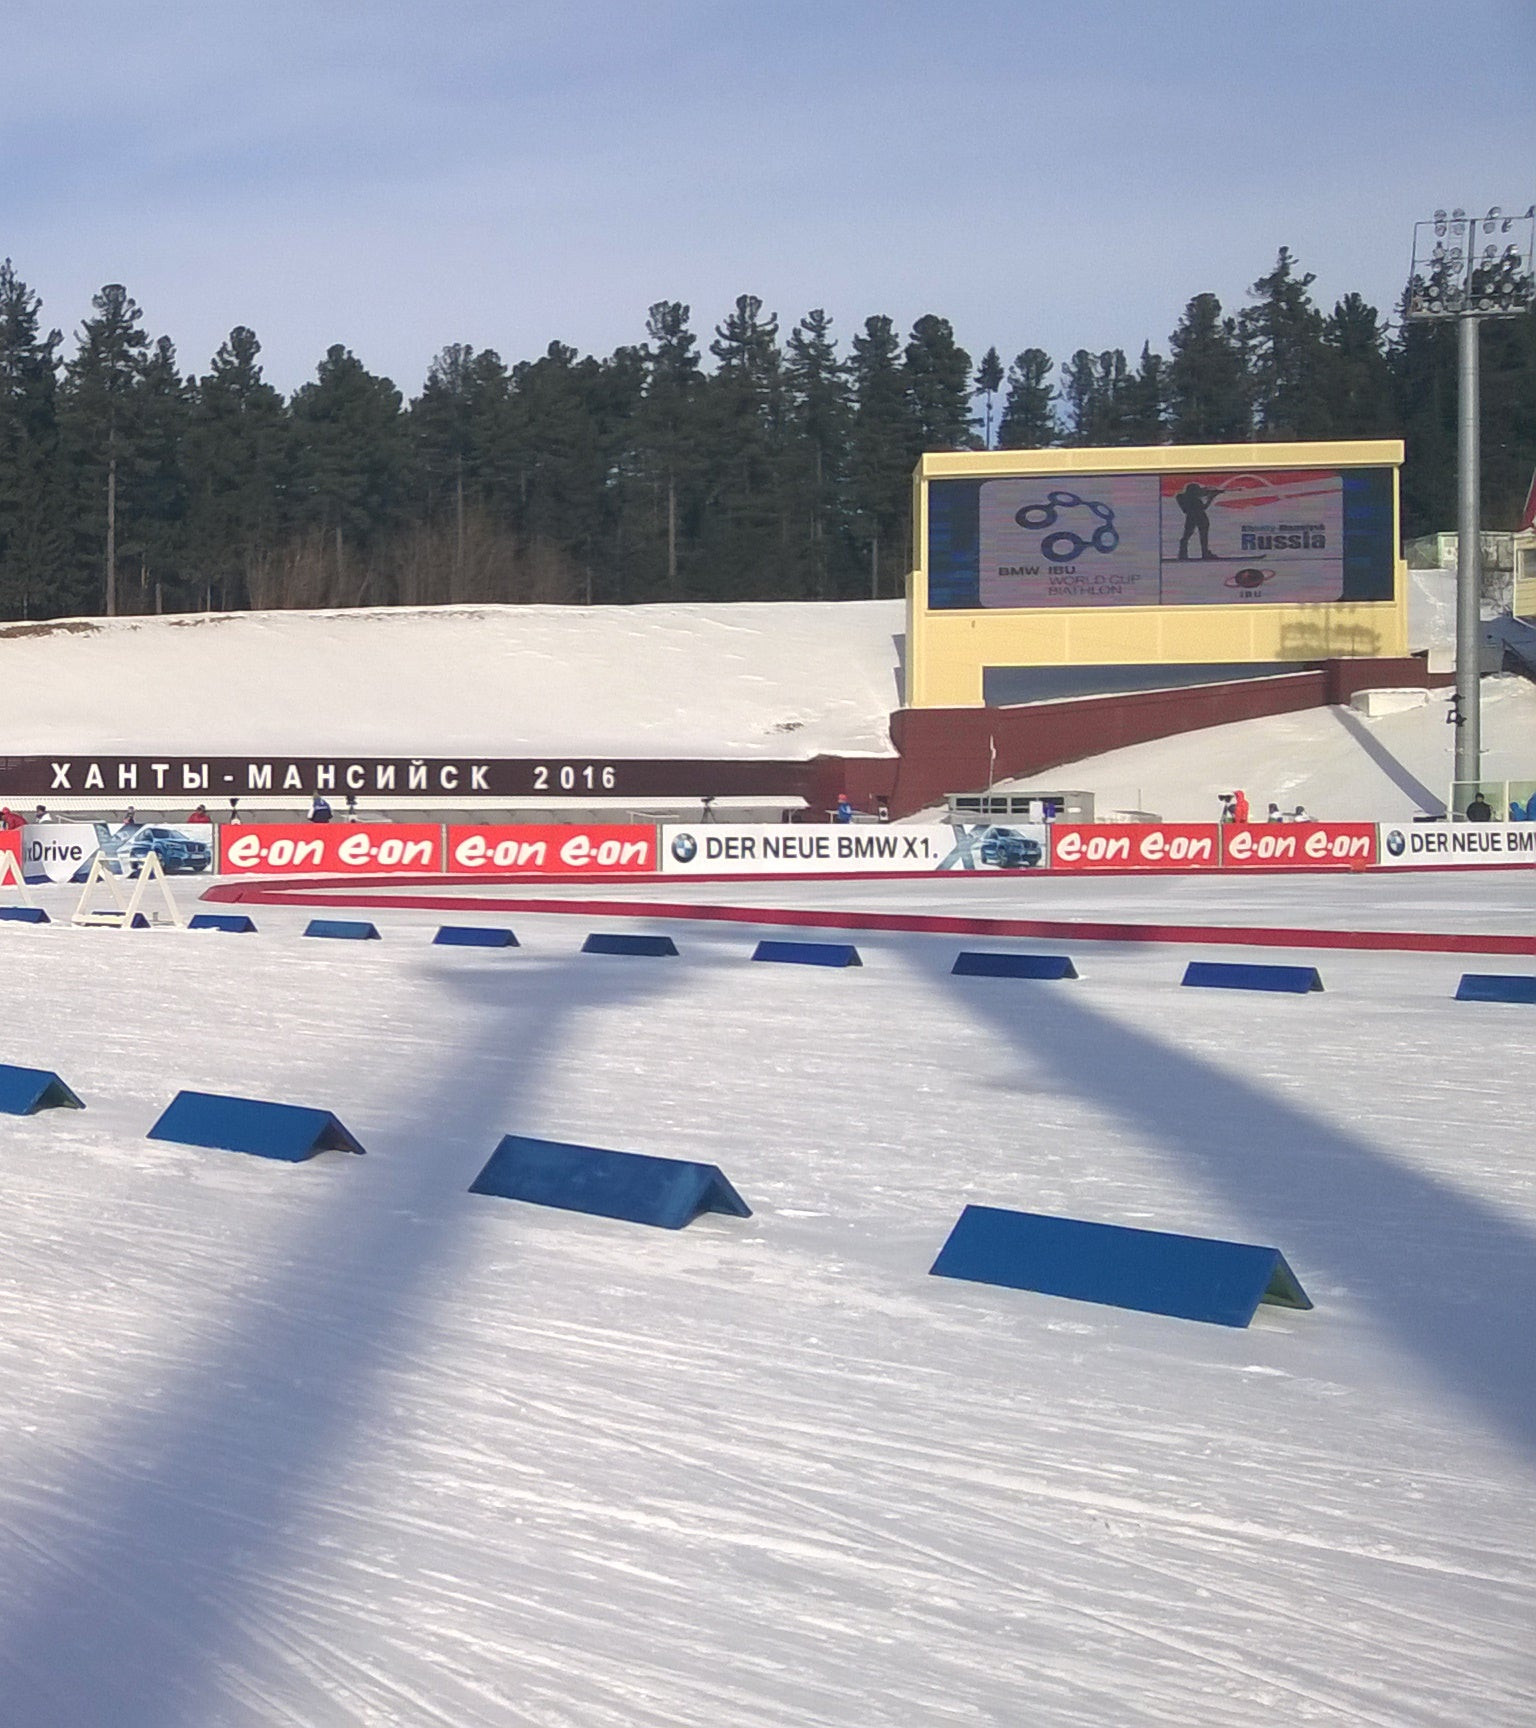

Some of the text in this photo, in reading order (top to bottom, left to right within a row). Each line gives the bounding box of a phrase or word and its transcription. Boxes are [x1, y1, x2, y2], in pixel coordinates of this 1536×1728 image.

[1241, 531, 1326, 550] Russia
[998, 566, 1076, 576] BMW IBU
[1048, 574, 1141, 585] WORLD CUP
[1048, 585, 1122, 596] BIATHLON
[533, 765, 615, 790] 2016
[706, 836, 939, 859] DER NEUE BMW X1.
[1411, 832, 1536, 852] DER NEUE BM
